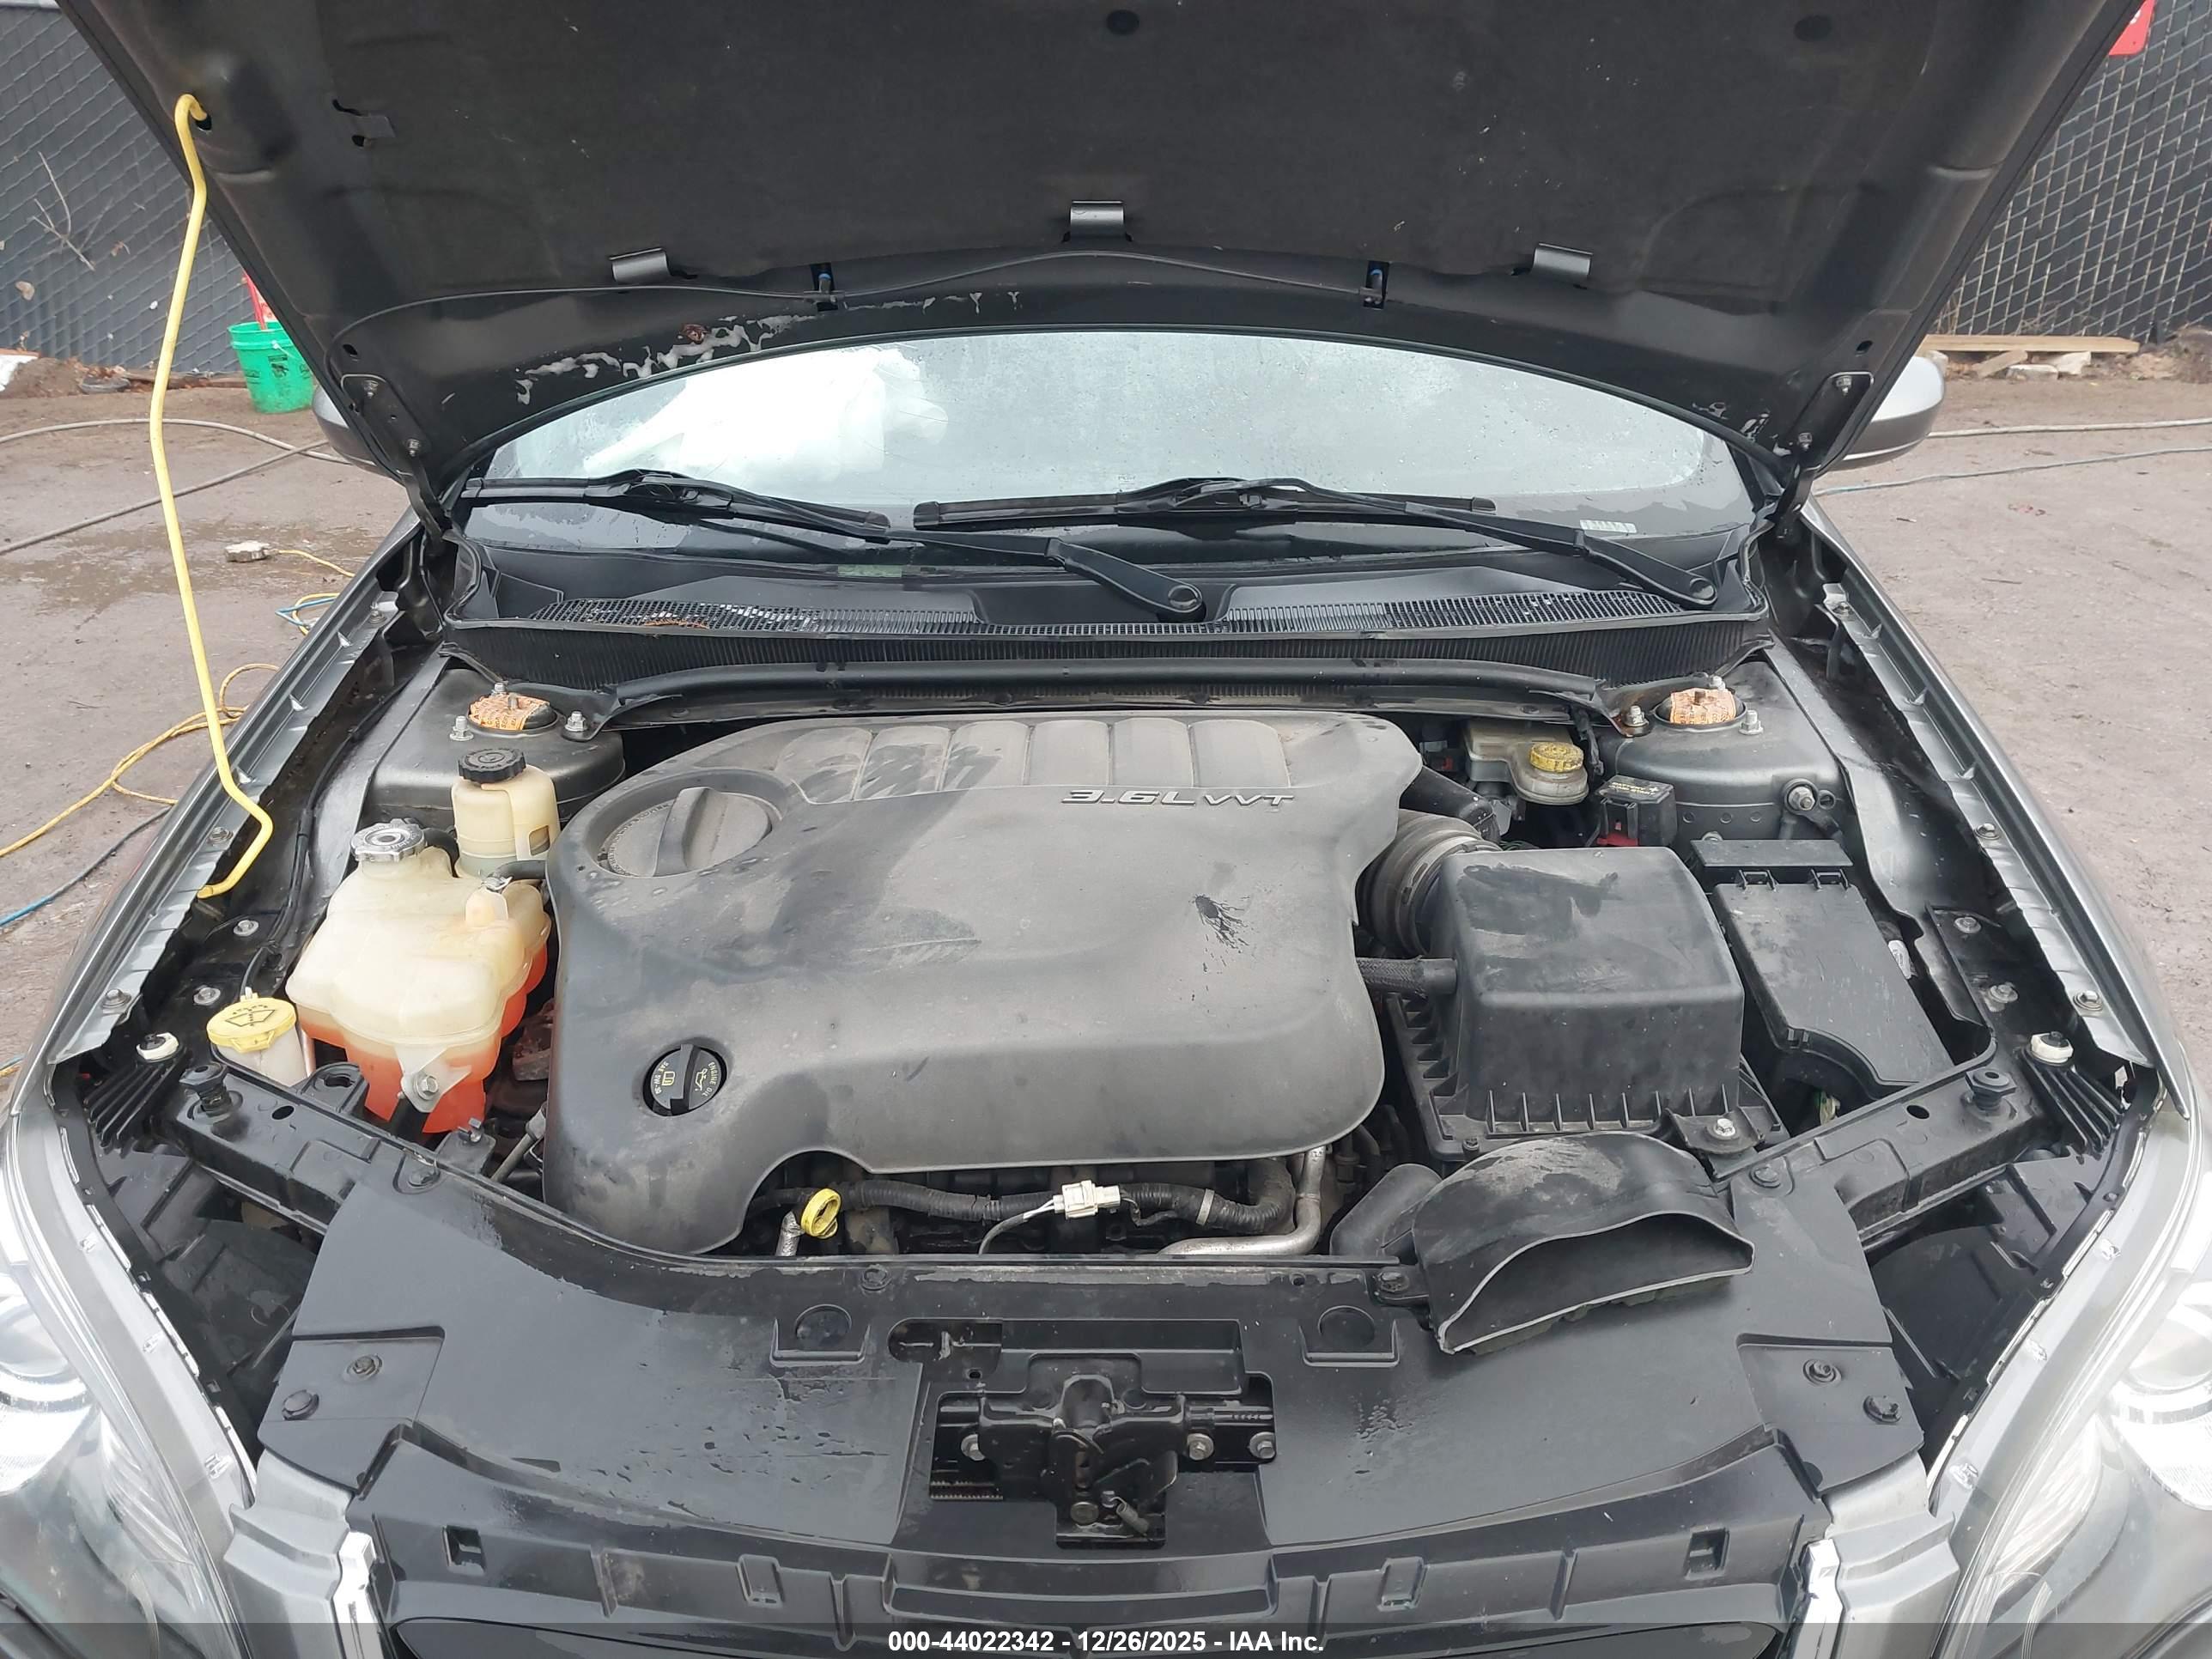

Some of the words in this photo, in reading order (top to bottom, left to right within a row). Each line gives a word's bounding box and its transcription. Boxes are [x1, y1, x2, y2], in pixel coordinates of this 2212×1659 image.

[1061, 788, 1196, 805] 3.6L
[1204, 793, 1295, 806] VVT
[658, 1060, 670, 1073] SAE
[708, 1061, 718, 1085] ENGINE
[702, 1087, 713, 1097] OIL
